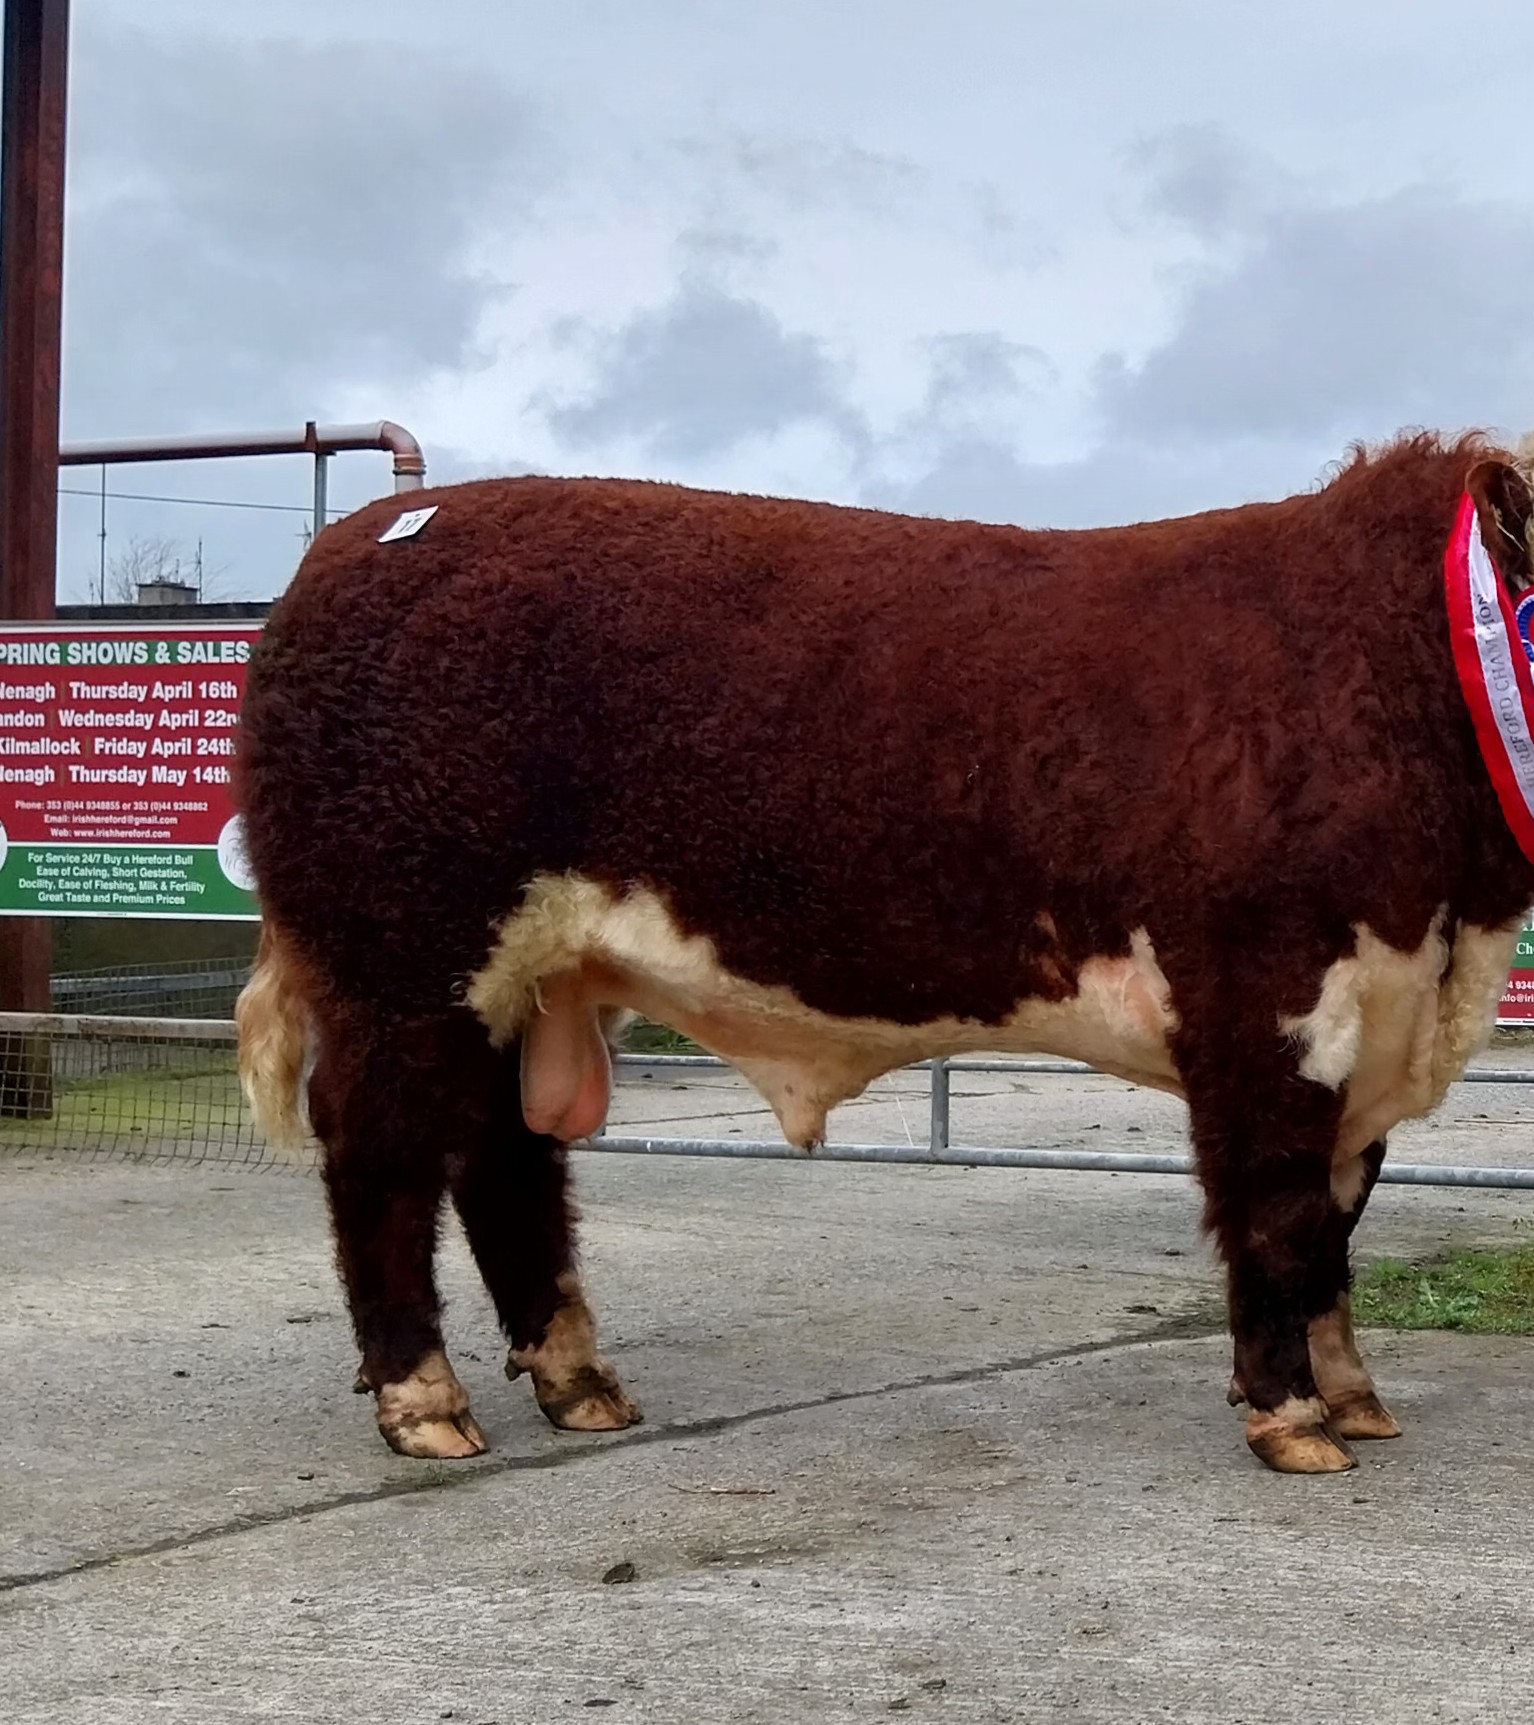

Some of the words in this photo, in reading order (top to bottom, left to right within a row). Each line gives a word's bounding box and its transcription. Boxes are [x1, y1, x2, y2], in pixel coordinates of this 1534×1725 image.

[67, 641, 149, 665] SHOWS
[154, 641, 171, 664] &
[177, 640, 250, 664] SALES
[69, 681, 148, 702] Thursday
[152, 681, 193, 702] April
[199, 681, 238, 699] 16th
[58, 709, 154, 730] Wednesday
[158, 709, 199, 730] April
[204, 709, 242, 727] 22n
[94, 737, 147, 758] Friday
[151, 737, 192, 759] April
[68, 765, 147, 786] Thursday
[152, 765, 187, 787] May
[192, 765, 231, 784] 14th
[15, 800, 44, 810] Phone:
[46, 801, 62, 810] 353
[63, 801, 84, 811] (0)44
[85, 801, 120, 811] 9348855
[133, 802, 149, 811] 353
[150, 802, 172, 813] (0)44
[44, 814, 71, 824] Email:
[72, 814, 178, 826] irishhereford@gmail.com
[50, 828, 72, 838] Web:
[73, 828, 171, 839] www.irishhereford.com
[28, 852, 43, 863] For
[45, 852, 80, 864] Service
[81, 853, 101, 864] 24/7
[103, 853, 122, 866] Buy
[123, 856, 130, 864] a
[131, 854, 173, 865] Hereford
[174, 855, 194, 866] Bull
[36, 865, 60, 876] Ease
[61, 866, 71, 877] of
[112, 867, 138, 878] Short
[139, 867, 188, 880] Gestation,
[58, 879, 81, 890] Ease
[82, 879, 92, 890] of
[138, 881, 159, 891] Milk
[160, 881, 168, 891] &
[169, 881, 206, 895] Fertility
[38, 891, 63, 902] Great
[65, 892, 92, 903] Taste
[93, 893, 111, 903] and
[112, 893, 154, 904] Premium
[155, 894, 186, 905] Prices
